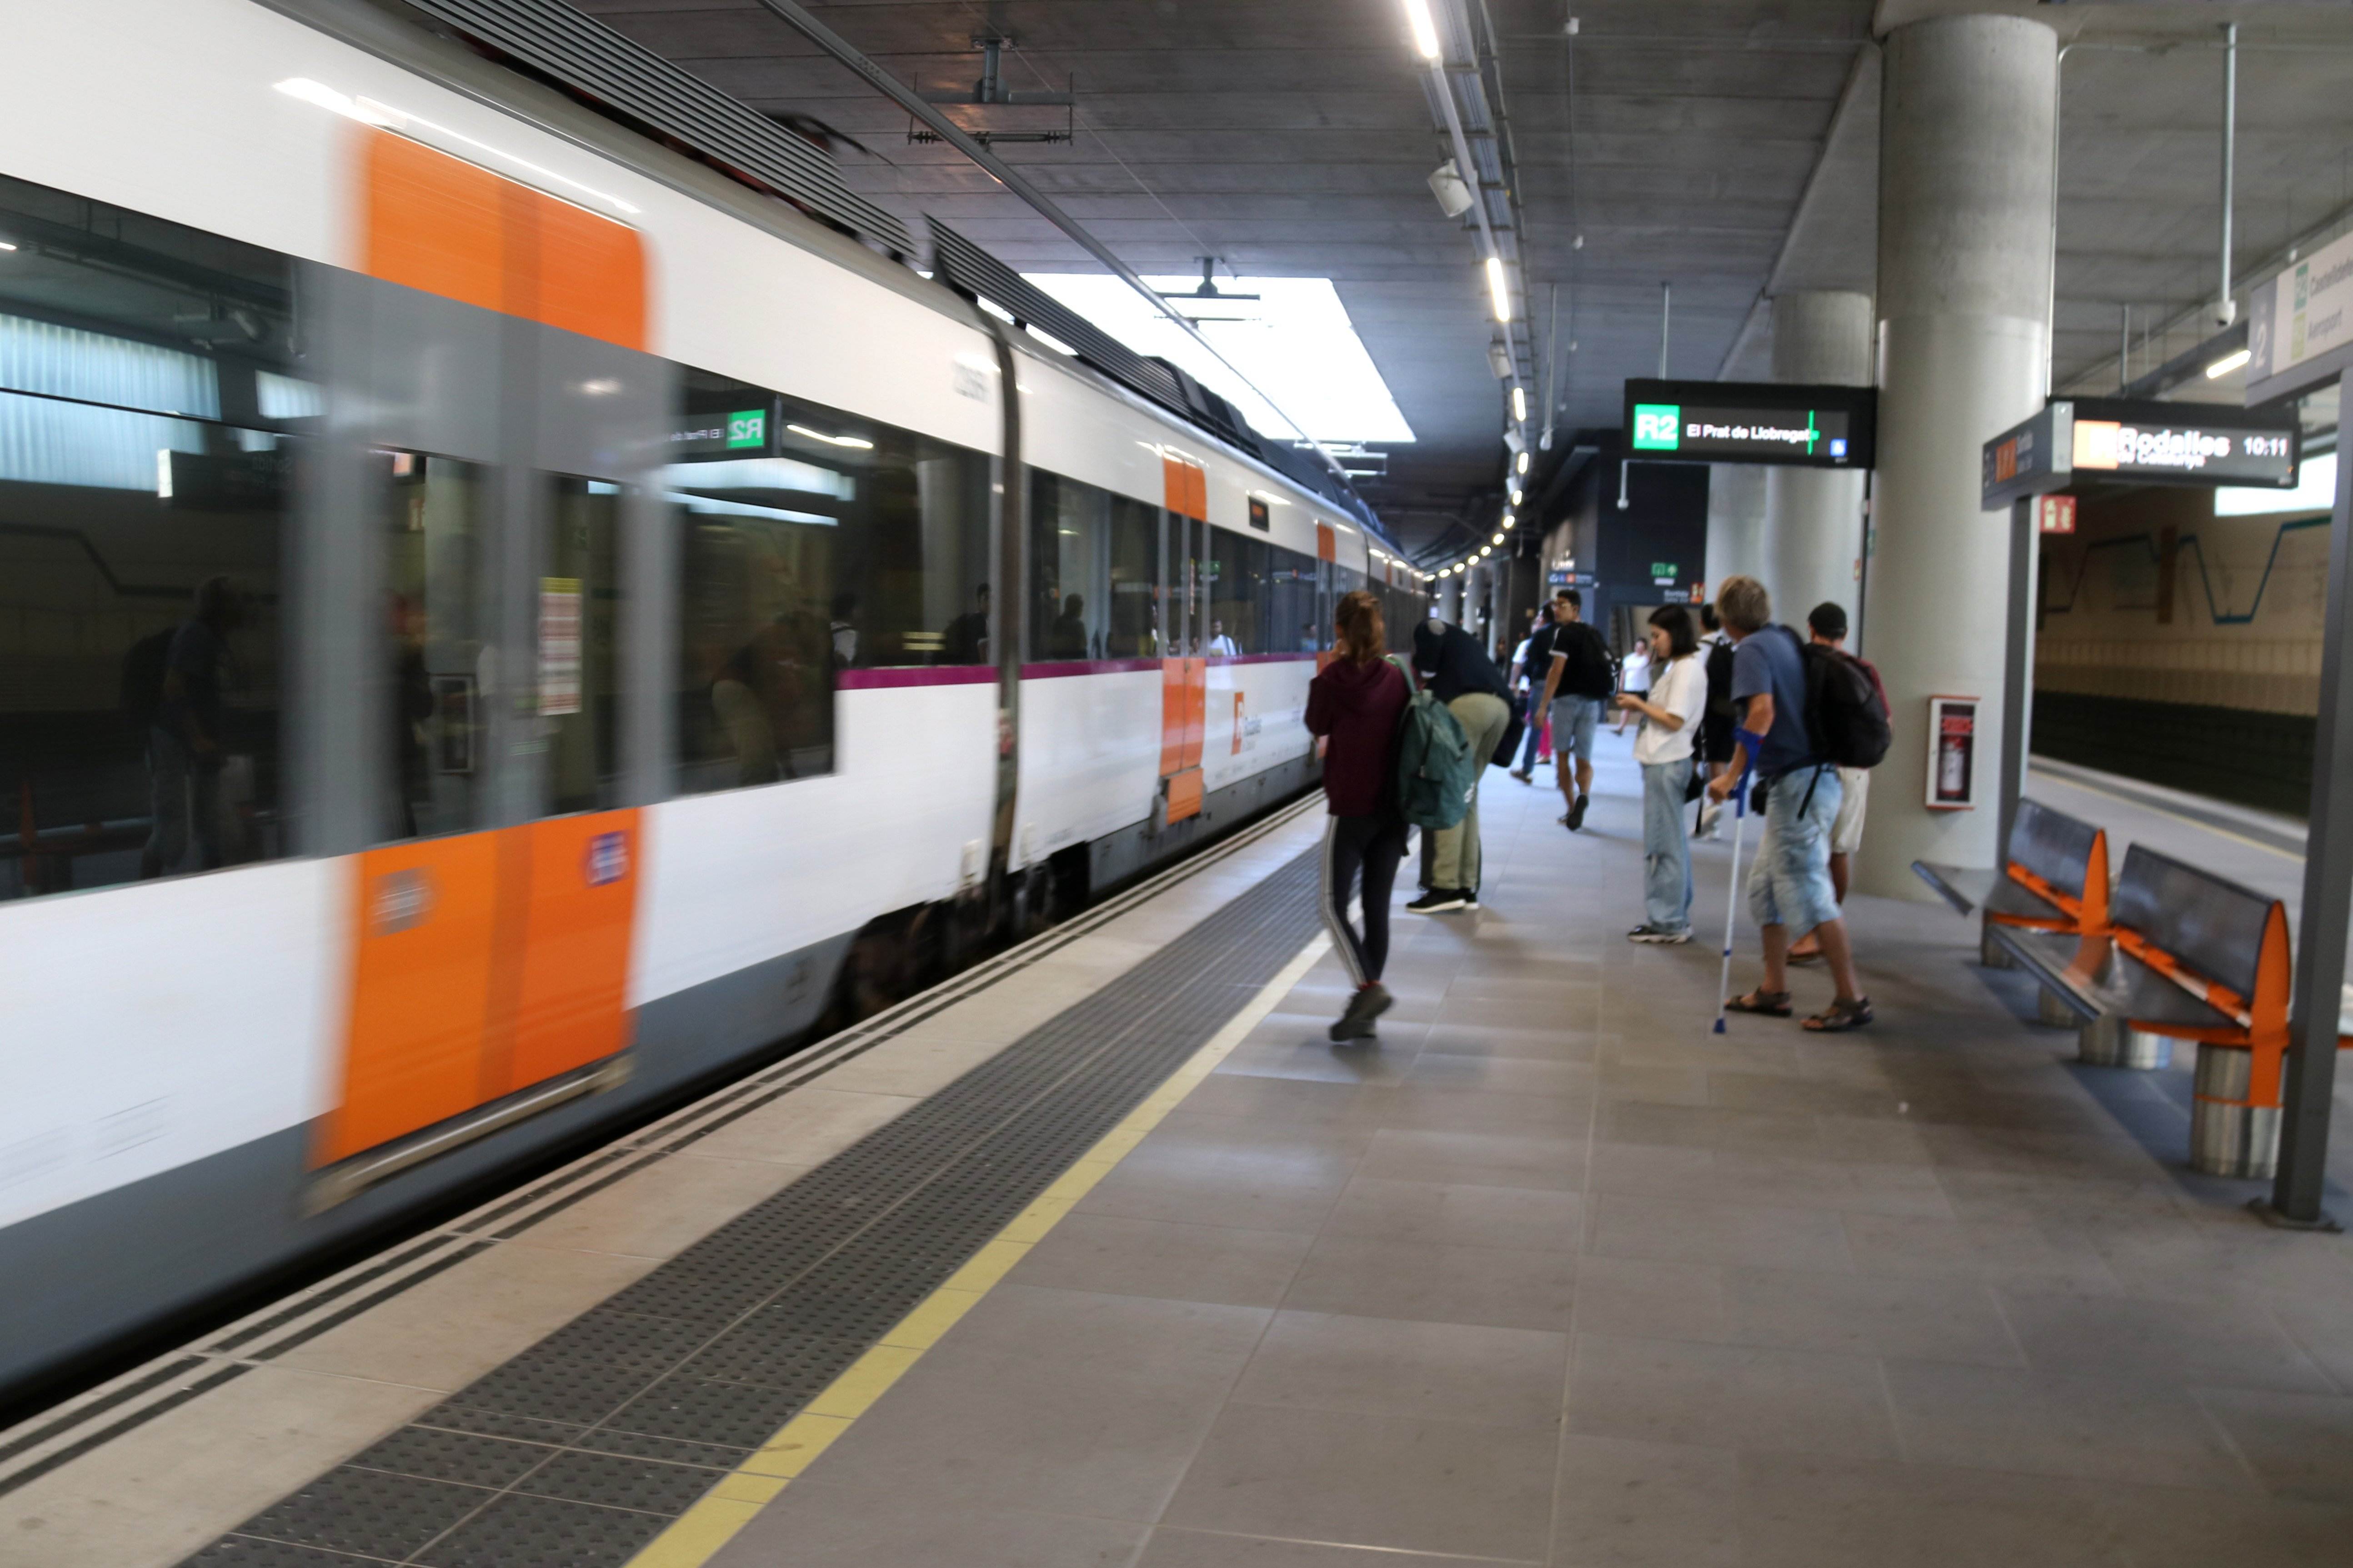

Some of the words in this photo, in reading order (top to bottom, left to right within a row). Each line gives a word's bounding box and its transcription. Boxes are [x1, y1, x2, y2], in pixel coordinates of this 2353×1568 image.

[1637, 414, 1678, 440] R2
[1687, 424, 1701, 438] El
[1702, 424, 1731, 439] Prat
[1731, 426, 1749, 439] de
[1751, 426, 1811, 444] Llobregat
[2117, 427, 2231, 457] Rodalies
[2243, 436, 2288, 457] 10:11
